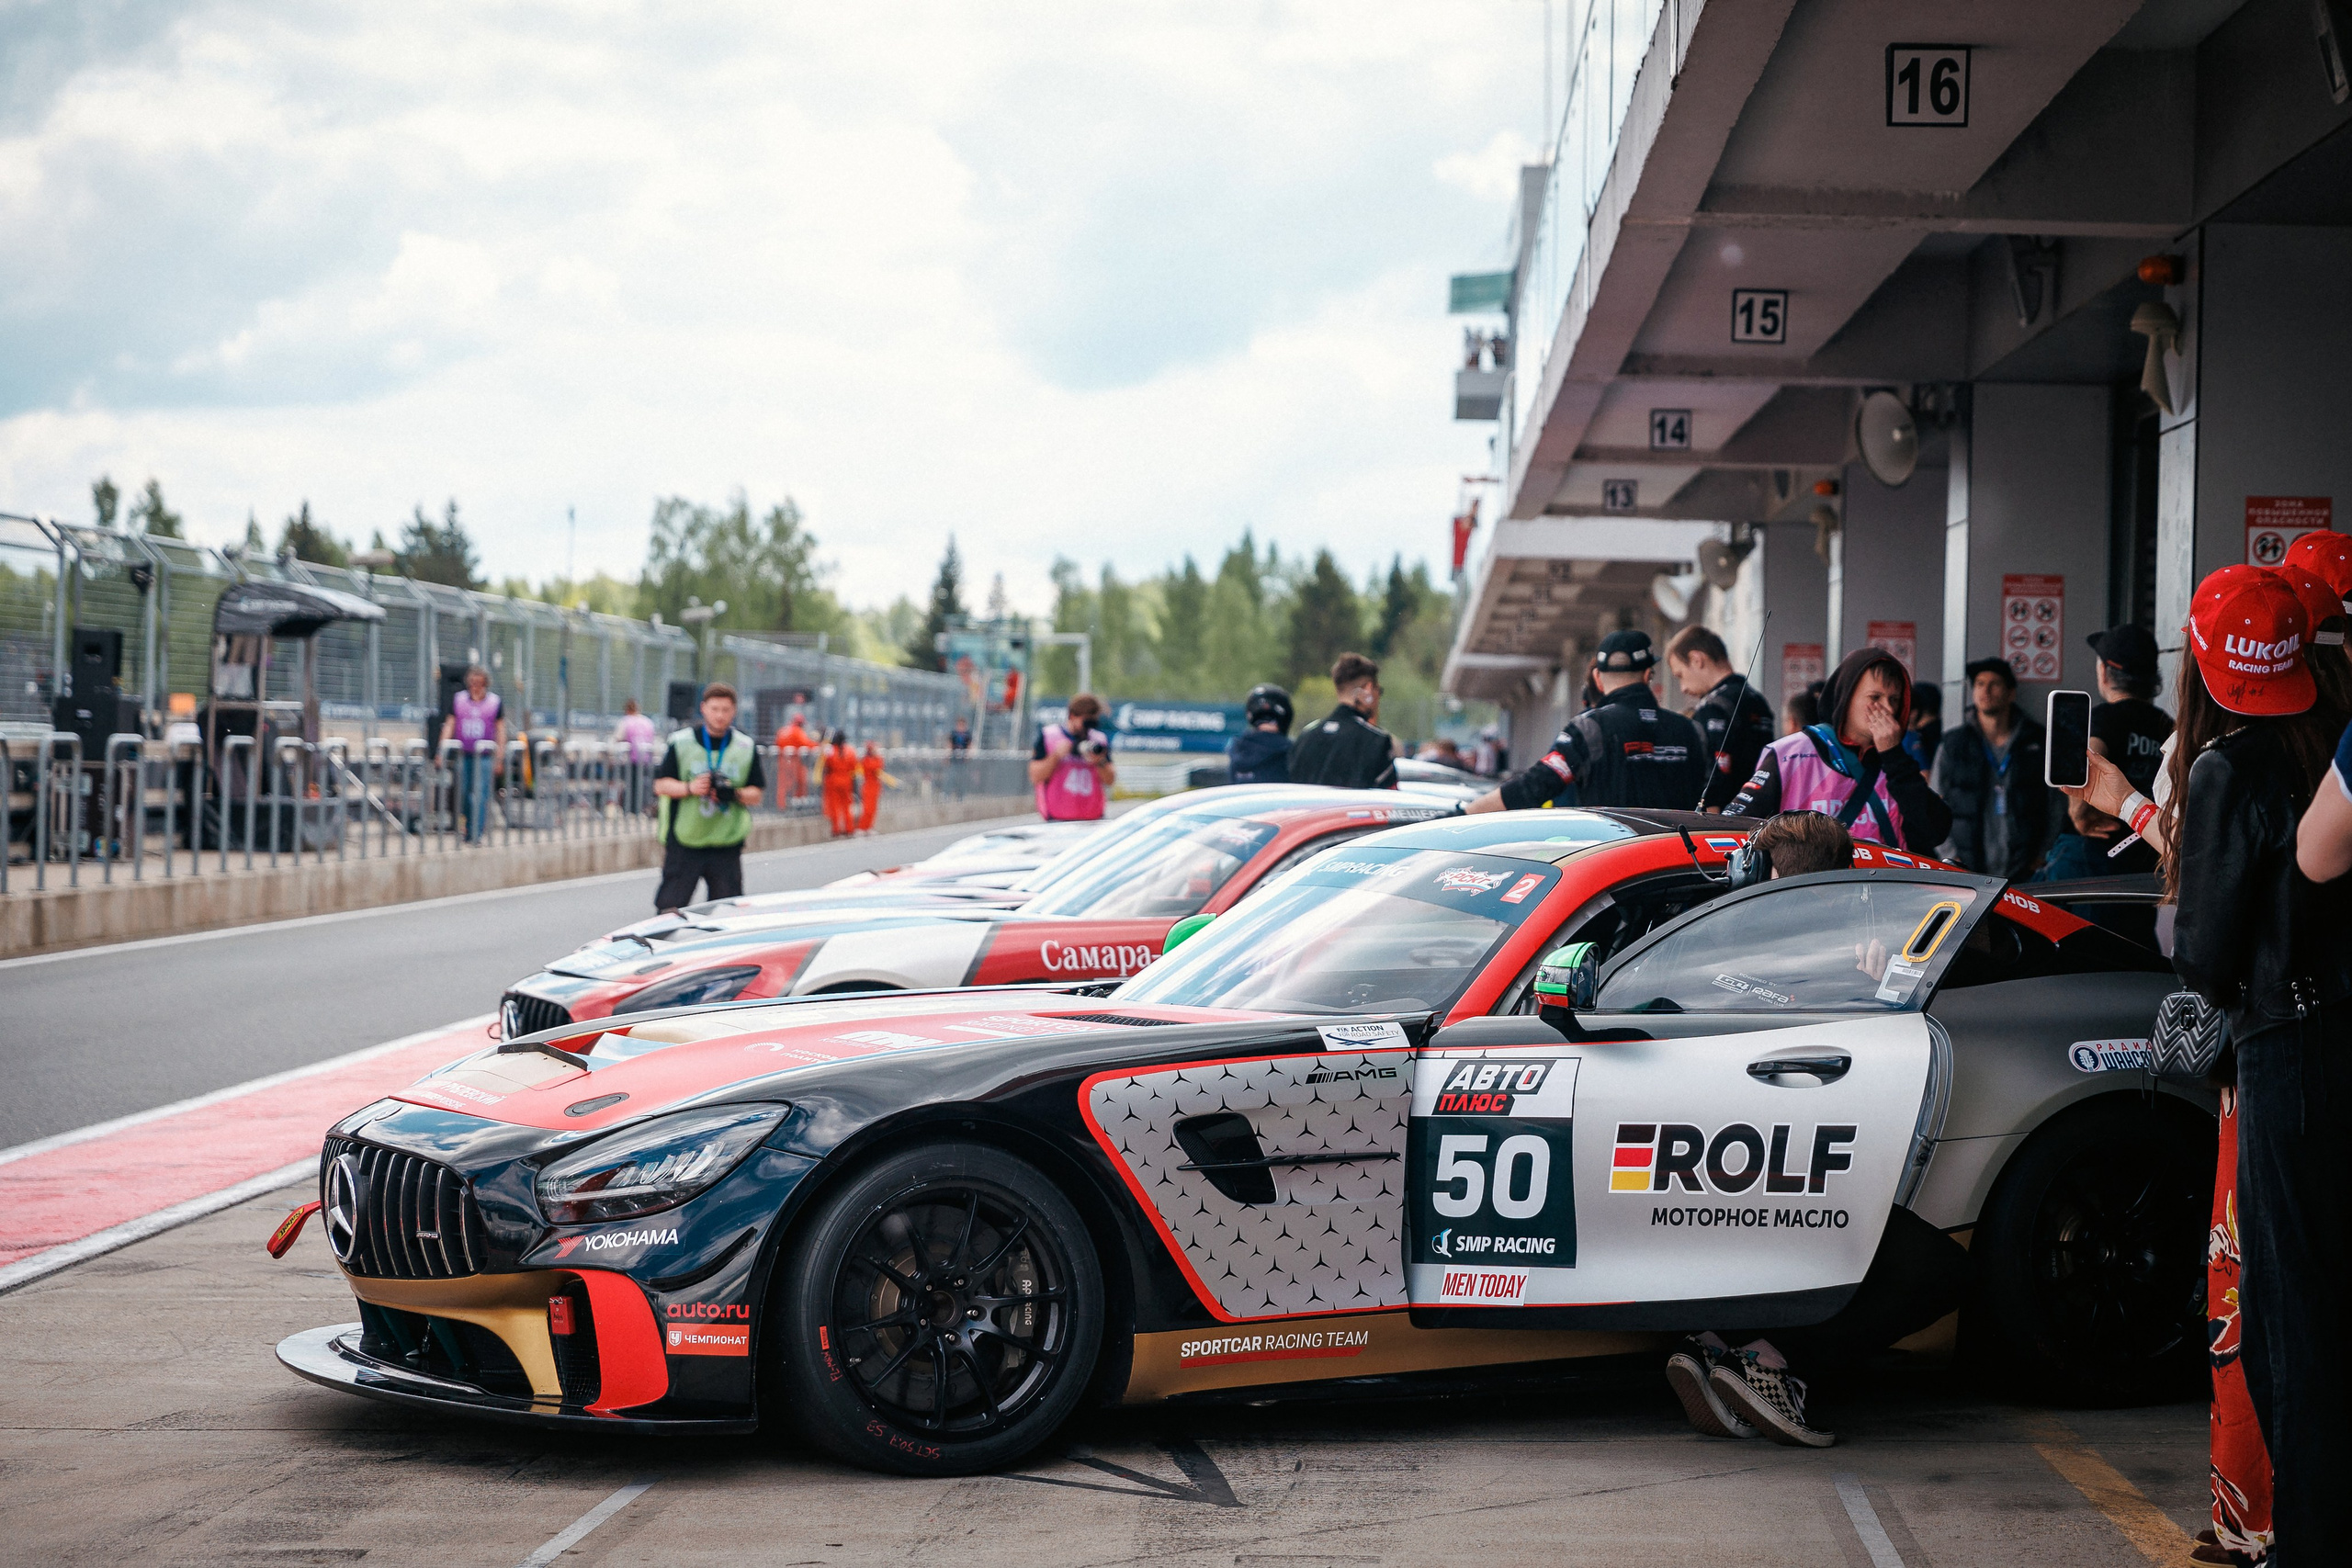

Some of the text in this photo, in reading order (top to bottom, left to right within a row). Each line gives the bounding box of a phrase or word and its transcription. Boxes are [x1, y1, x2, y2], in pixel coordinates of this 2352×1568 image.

[1898, 57, 1961, 116] 16
[1739, 297, 1781, 336] 15
[1657, 415, 1686, 444] 14
[1609, 486, 1634, 507] 13
[2224, 633, 2301, 661] LUKOIL
[2228, 658, 2294, 674] RACING TEAM
[1506, 878, 1537, 899] 2
[2100, 1051, 2151, 1070] ШАНСО
[1333, 1066, 1397, 1082] AMG
[1445, 1063, 1547, 1091] АВТО
[1438, 1093, 1508, 1112] ПЛЮС
[1651, 1121, 1860, 1196] ROLF
[1432, 1134, 1552, 1219] 50
[1651, 1207, 1849, 1229] МОТОРНОЕ МАСЛО
[584, 1228, 679, 1252] YOKOHAMA
[1455, 1235, 1555, 1255] SMP RACING
[1442, 1272, 1527, 1299] MEN TODAY
[666, 1302, 750, 1319] auto.ru
[684, 1335, 747, 1346] ЧЕМПИОНАТ
[1181, 1330, 1369, 1358] SPORTCAR RACING TEAM
